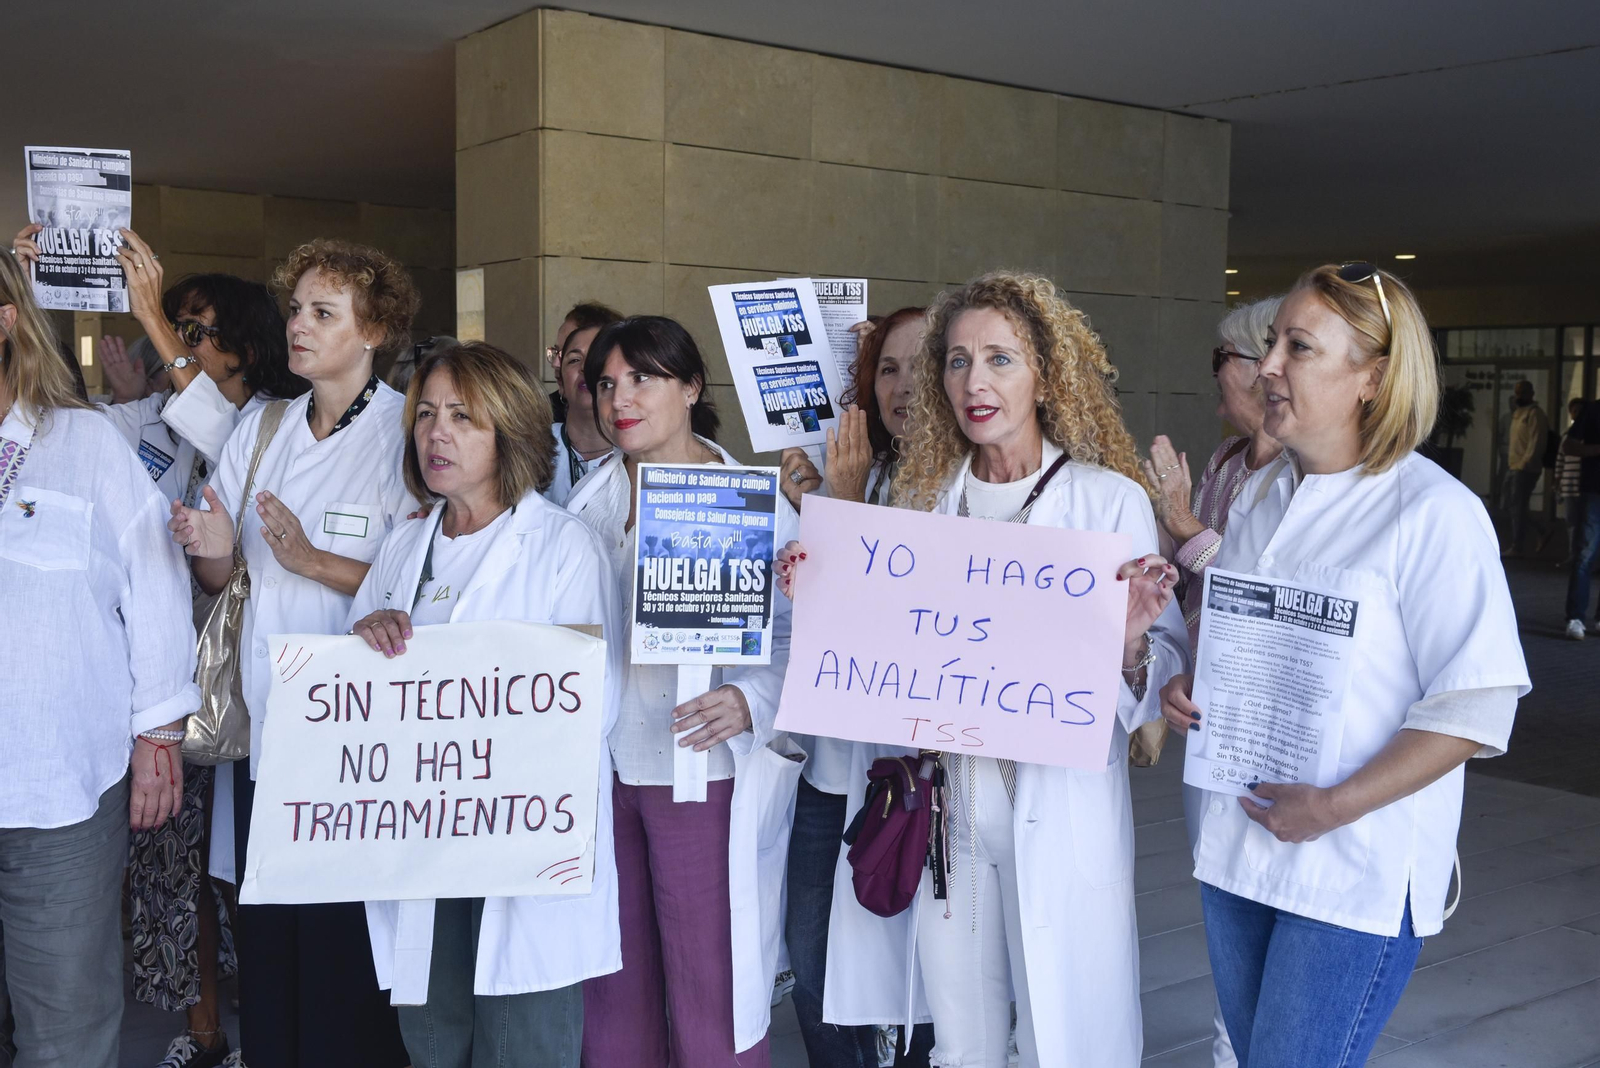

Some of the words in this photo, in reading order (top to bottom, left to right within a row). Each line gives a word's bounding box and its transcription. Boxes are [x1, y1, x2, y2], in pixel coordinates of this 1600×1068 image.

[33, 154, 58, 165] Ministerio
[60, 157, 67, 166] de
[69, 157, 92, 168] Sanidad
[94, 160, 100, 168] no
[102, 161, 125, 171] cumple
[68, 173, 83, 182] paga
[68, 188, 75, 197] de
[77, 188, 92, 199] Salud
[94, 192, 103, 200] nos
[37, 228, 90, 255] HUELGA
[93, 229, 123, 256] TSS
[39, 255, 63, 263] Técnicos
[64, 257, 91, 265] Superiores
[97, 267, 122, 275] noviembre
[753, 292, 774, 300] Superiores
[813, 282, 843, 295] HUELGA
[846, 283, 861, 295] TSS
[739, 307, 747, 315] en
[747, 302, 773, 313] servicios
[742, 316, 784, 336] HUELGA
[783, 314, 805, 332] TSS
[756, 367, 775, 375] Técnicos
[775, 366, 797, 374] Superiores
[797, 364, 817, 372] Sanitarios
[769, 377, 795, 389] servicios
[763, 390, 806, 412] HUELGA
[805, 387, 827, 407] TSS
[150, 465, 162, 479] TSS
[648, 471, 685, 484] Ministerio
[688, 474, 698, 485] de
[699, 474, 729, 487] Sanidad
[731, 479, 740, 488] no
[742, 478, 770, 490] cumple
[647, 492, 683, 503] Hacienda
[685, 494, 695, 503] no
[697, 493, 716, 504] paga
[655, 507, 695, 521] Consejerías
[697, 511, 706, 522] de
[708, 511, 726, 523] Salud
[728, 515, 740, 524] nos
[742, 513, 768, 527] ignoran
[671, 531, 711, 549] Basta
[643, 558, 721, 591] HUELGA
[729, 559, 765, 591] TSS
[861, 536, 915, 578] YO
[967, 554, 1095, 597] HAGO
[1213, 576, 1229, 584] Ministerio
[1235, 581, 1249, 589] Sanidad
[1256, 585, 1269, 593] cumple
[643, 592, 678, 601] Técnicos
[680, 592, 722, 603] Superiores
[725, 593, 764, 602] Sanitarios
[1275, 587, 1324, 616] HUELGA
[1327, 598, 1353, 622] TSS
[643, 603, 651, 612] 30
[652, 604, 656, 613] y
[658, 603, 665, 612] 31
[666, 603, 673, 612] de
[675, 603, 699, 612] octubre
[706, 604, 710, 612] 3
[716, 604, 720, 612] 4
[722, 604, 730, 612] de
[731, 604, 764, 613] noviembre
[1211, 612, 1230, 620] Estimado
[909, 609, 991, 642] TUS
[1274, 608, 1296, 617] Técnicos
[1297, 612, 1322, 623] Superiores
[1323, 619, 1350, 629] Sanitarios
[1294, 618, 1307, 626] octubre
[1326, 626, 1349, 636] noviembre
[1234, 646, 1265, 656] ¿Quiénes
[1268, 652, 1288, 660] somos
[1300, 659, 1313, 668] TSS?
[1244, 700, 1261, 708] ¿Qué
[1263, 704, 1292, 716] pedimos?
[903, 718, 984, 746] TSS
[1218, 724, 1252, 734] queremos
[1267, 734, 1277, 742] nos
[1278, 739, 1298, 749] regalen
[1300, 746, 1317, 754] nada
[1212, 731, 1246, 742] Queremos
[1270, 745, 1288, 755] cumpla
[1297, 754, 1308, 762] Ley
[339, 742, 388, 783] NO
[416, 738, 492, 782] HAY
[1254, 751, 1265, 760] hay
[1267, 755, 1298, 772] Diagnóstico
[1252, 760, 1262, 768] hay
[1264, 764, 1298, 781] Tratamiento
